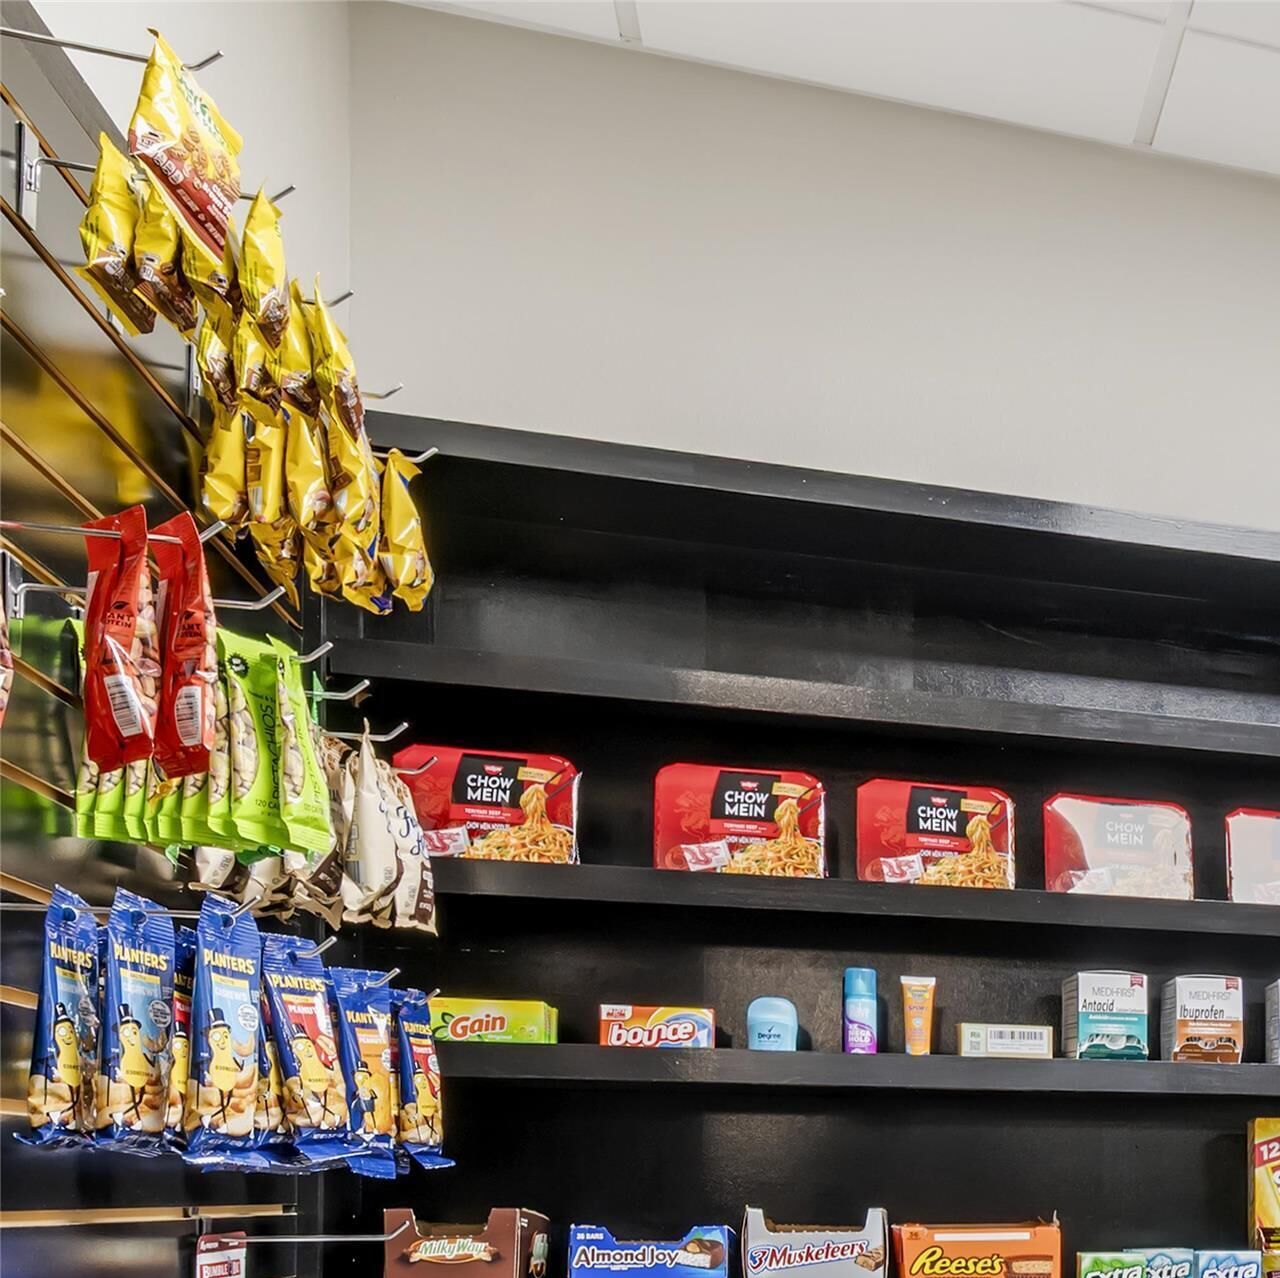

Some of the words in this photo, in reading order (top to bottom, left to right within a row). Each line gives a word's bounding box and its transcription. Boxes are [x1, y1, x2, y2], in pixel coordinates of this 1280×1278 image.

[466, 774, 514, 789] CHOW
[466, 788, 511, 803] MEIN
[724, 791, 769, 804] CHOW
[724, 803, 766, 818] MEIN
[917, 806, 959, 820] CHOW
[918, 818, 957, 833] MEIN
[1105, 821, 1145, 835] CHOW
[1106, 832, 1145, 846] MEIN
[114, 943, 169, 971] PLANTERS
[204, 949, 257, 975] PLANTERS
[272, 974, 326, 992] PLANTERS
[1092, 986, 1136, 998] MEDI-FIRST
[1189, 990, 1232, 1002] MEDI-FIRST
[1081, 1000, 1115, 1014] Antacid
[1180, 1004, 1225, 1021] Ibuprofen
[449, 1012, 507, 1040] Gain
[609, 1021, 698, 1047] bounce
[574, 1246, 647, 1268] Almond
[647, 1245, 679, 1268] Joy
[749, 1249, 769, 1273] 3
[767, 1239, 868, 1270] Musketeers
[910, 1245, 1004, 1276] Reese's
